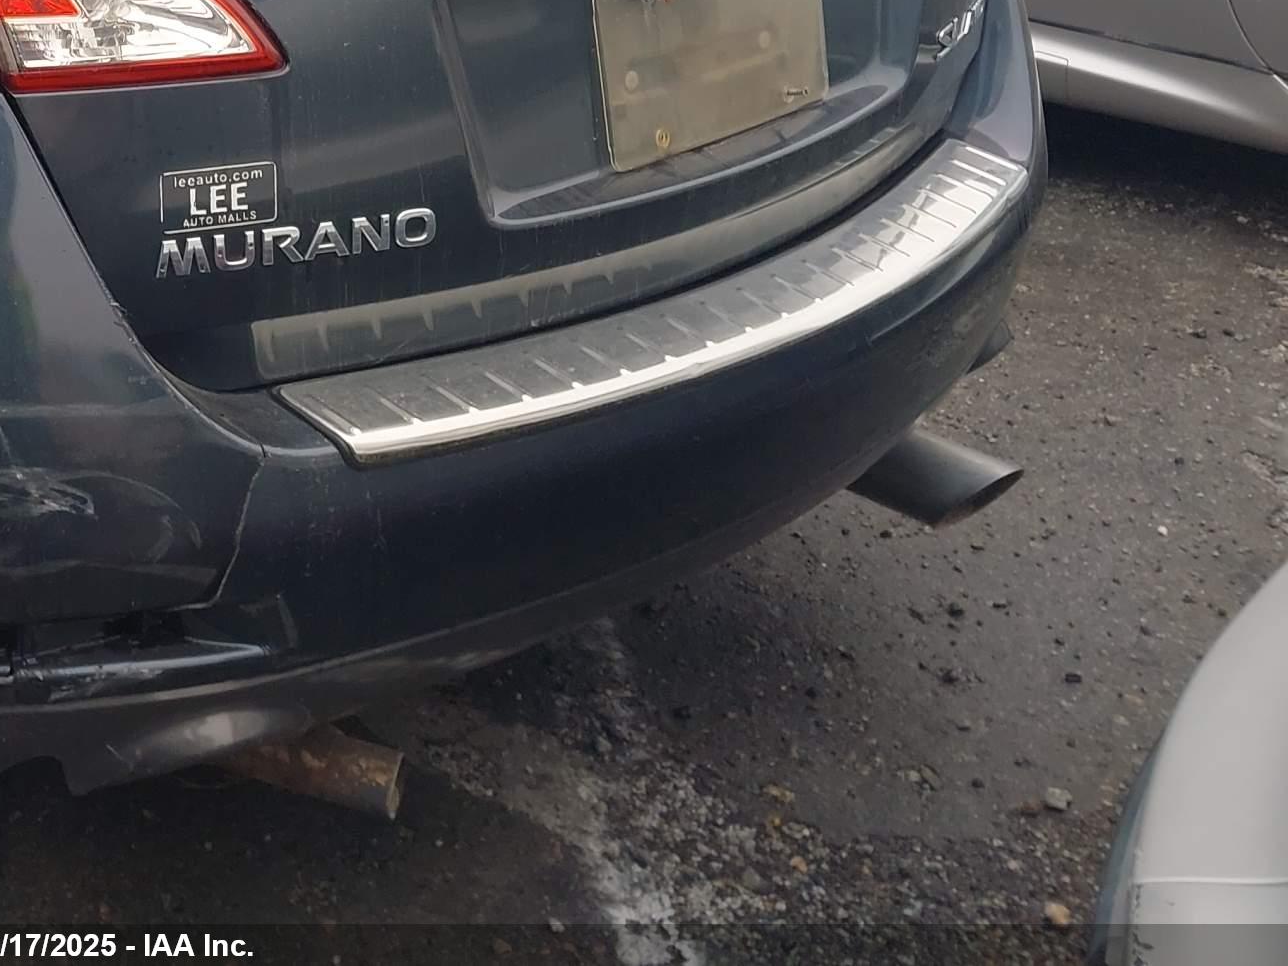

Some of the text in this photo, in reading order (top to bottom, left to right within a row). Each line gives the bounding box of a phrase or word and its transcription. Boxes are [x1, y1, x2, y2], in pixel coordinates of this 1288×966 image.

[189, 181, 249, 216] LEE
[183, 210, 257, 229] AUTO MALLS
[155, 207, 437, 279] MURANO
